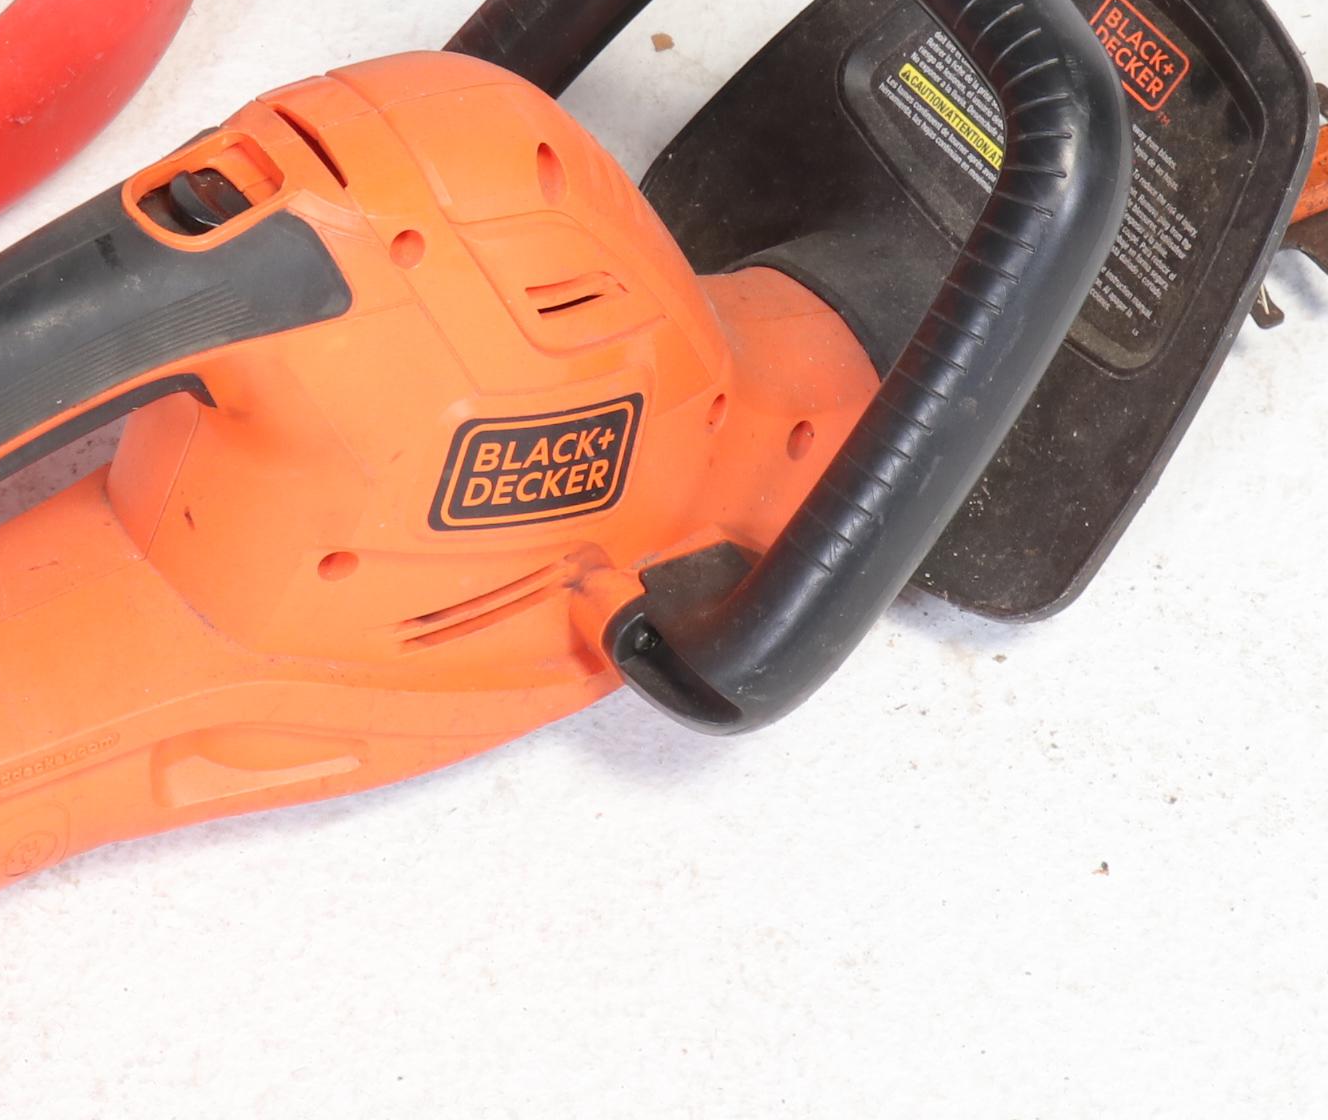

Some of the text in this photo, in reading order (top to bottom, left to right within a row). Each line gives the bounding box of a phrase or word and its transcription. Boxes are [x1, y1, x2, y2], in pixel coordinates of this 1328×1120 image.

[1102, 6, 1179, 79] BLACK+
[473, 427, 615, 473] BLACK+
[461, 458, 610, 508] DECKER
